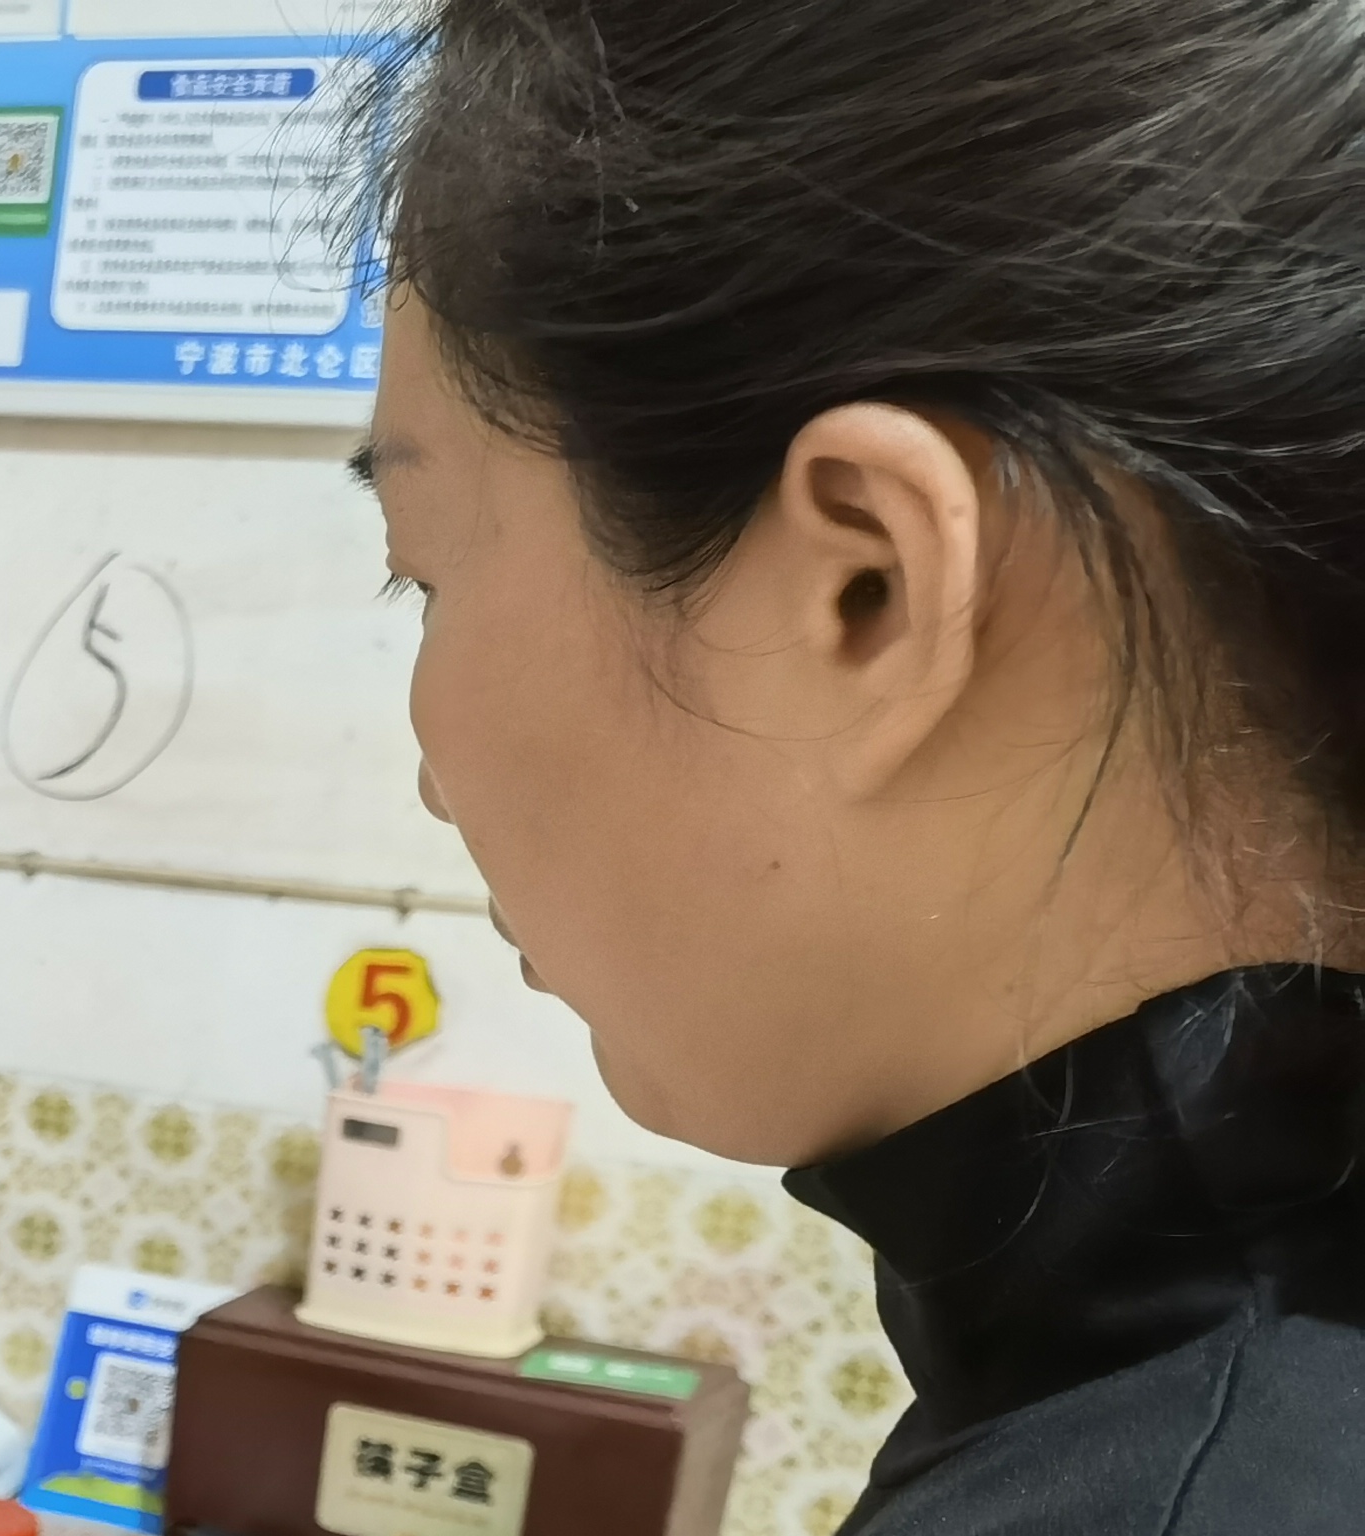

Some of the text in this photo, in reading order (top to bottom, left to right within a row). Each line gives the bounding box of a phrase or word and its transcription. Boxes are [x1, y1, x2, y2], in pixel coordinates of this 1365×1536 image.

[36, 582, 127, 781] 5
[358, 963, 413, 1047] 5
[355, 1437, 494, 1505] 筷子盒
